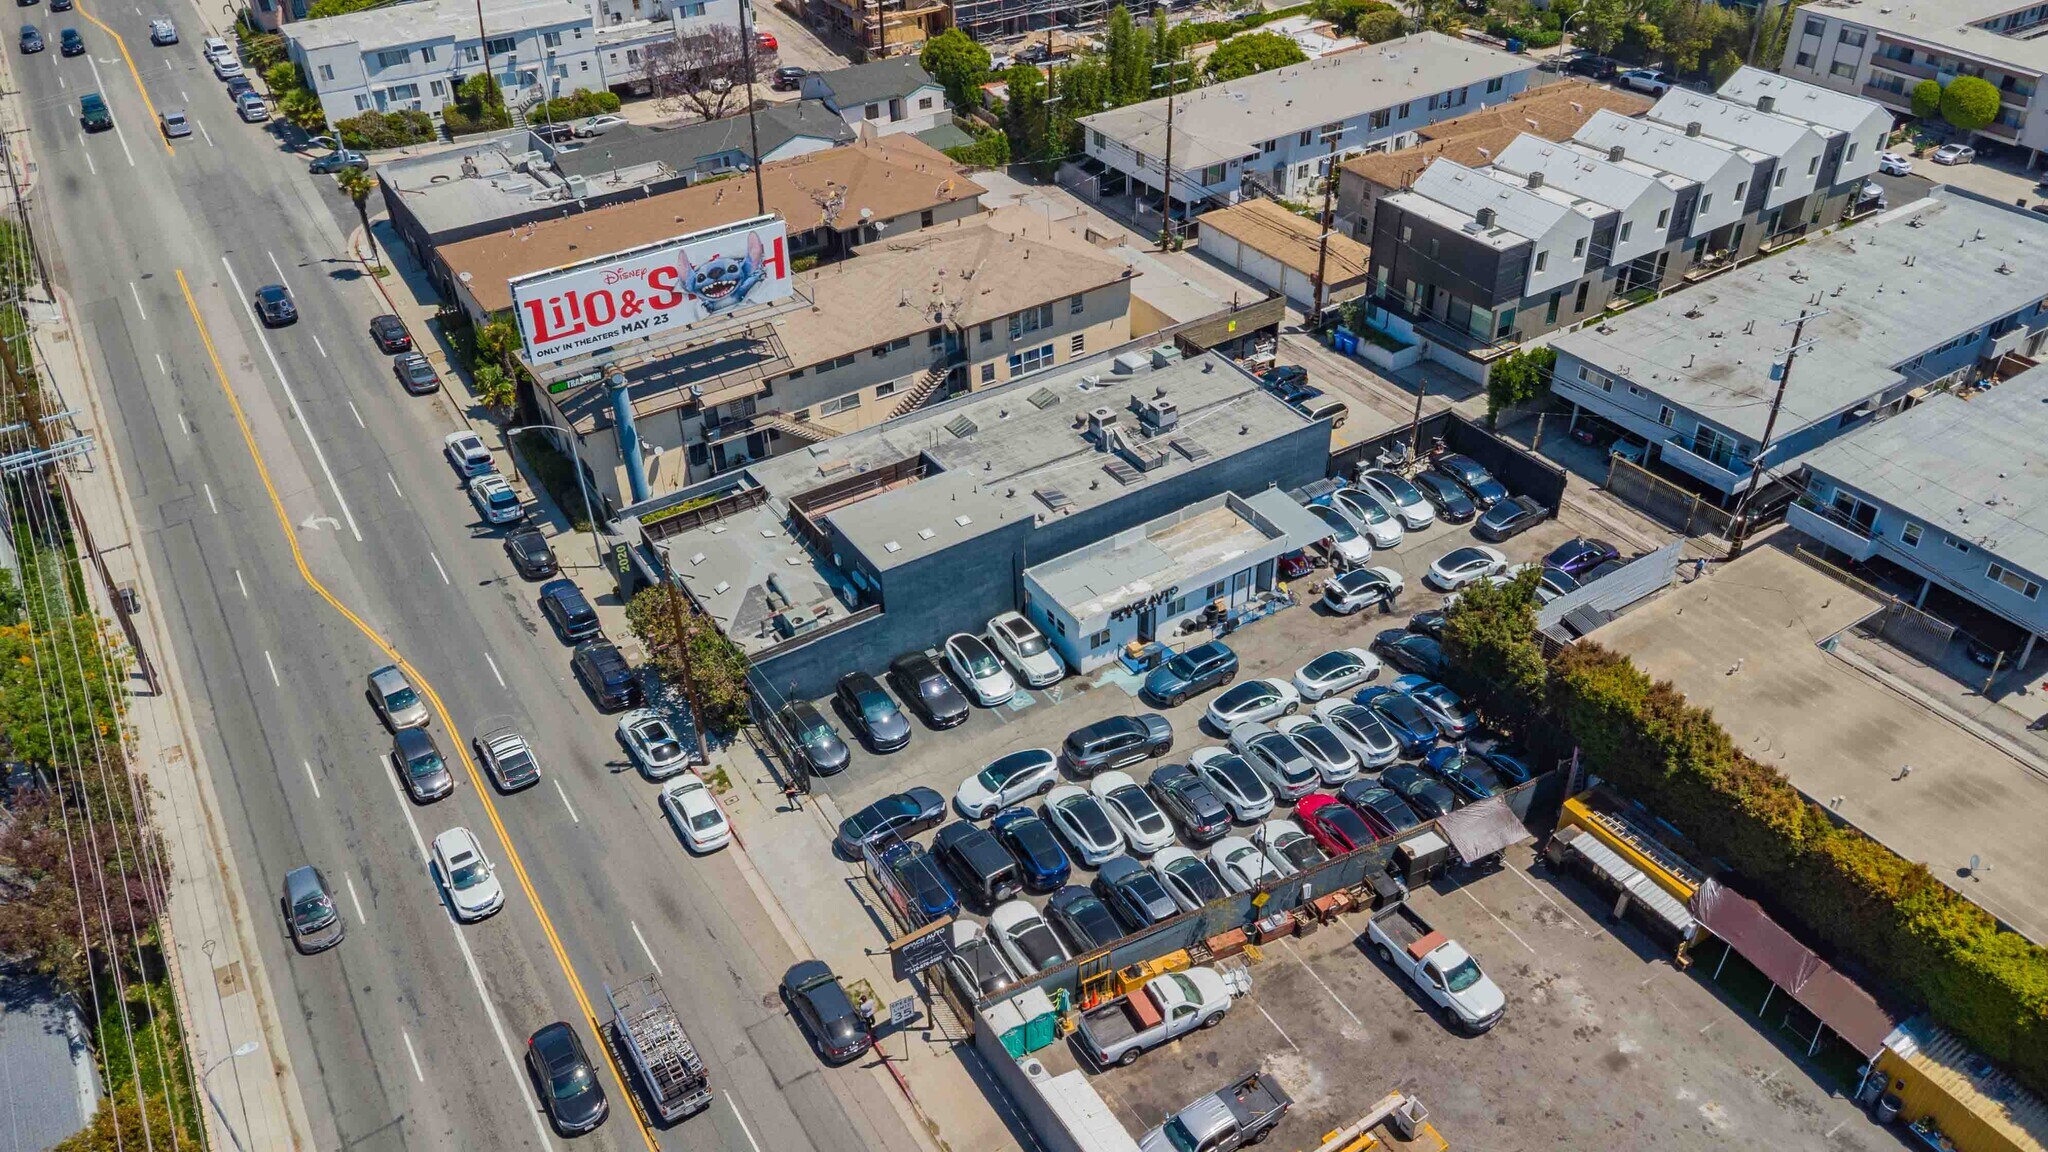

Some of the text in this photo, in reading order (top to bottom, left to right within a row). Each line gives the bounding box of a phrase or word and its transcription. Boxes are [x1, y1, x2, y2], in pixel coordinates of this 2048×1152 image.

[620, 289, 645, 318] &
[536, 313, 669, 358] ONLY IN THEATERS MAY 23
[566, 372, 602, 389] TRAON
[615, 545, 631, 573] 2020
[1148, 586, 1179, 606] AUTO
[926, 927, 946, 941] AUTO
[893, 1003, 911, 1013] LIMIT
[894, 1008, 912, 1021] 35
